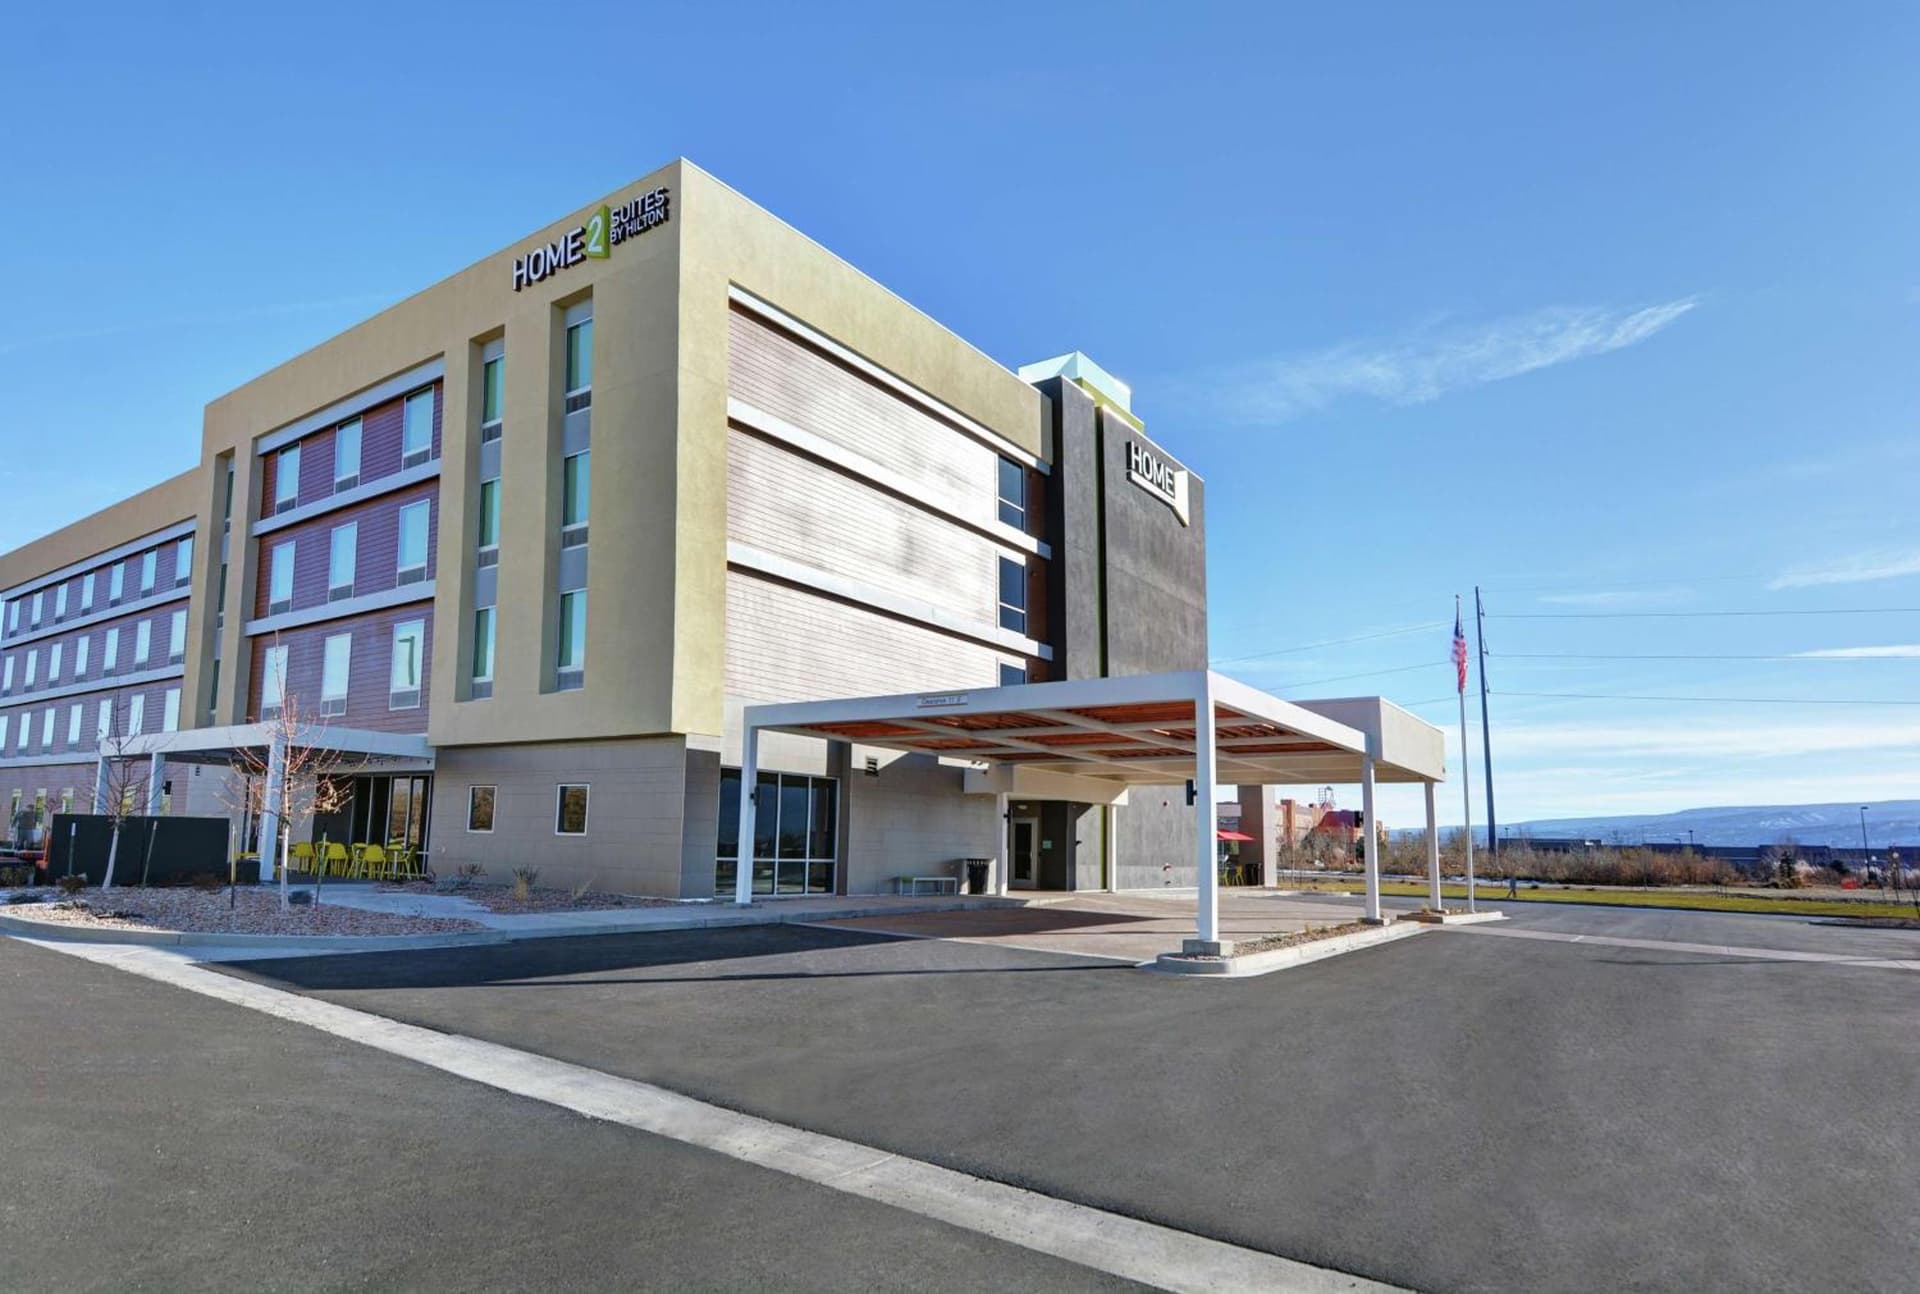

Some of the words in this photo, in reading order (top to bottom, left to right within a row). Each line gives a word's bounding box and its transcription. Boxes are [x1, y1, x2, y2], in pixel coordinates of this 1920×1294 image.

[610, 186, 665, 228] SUITES
[610, 224, 624, 243] BY
[625, 205, 665, 235] HILTON
[512, 227, 583, 290] HOME
[1131, 440, 1175, 496] HOME
